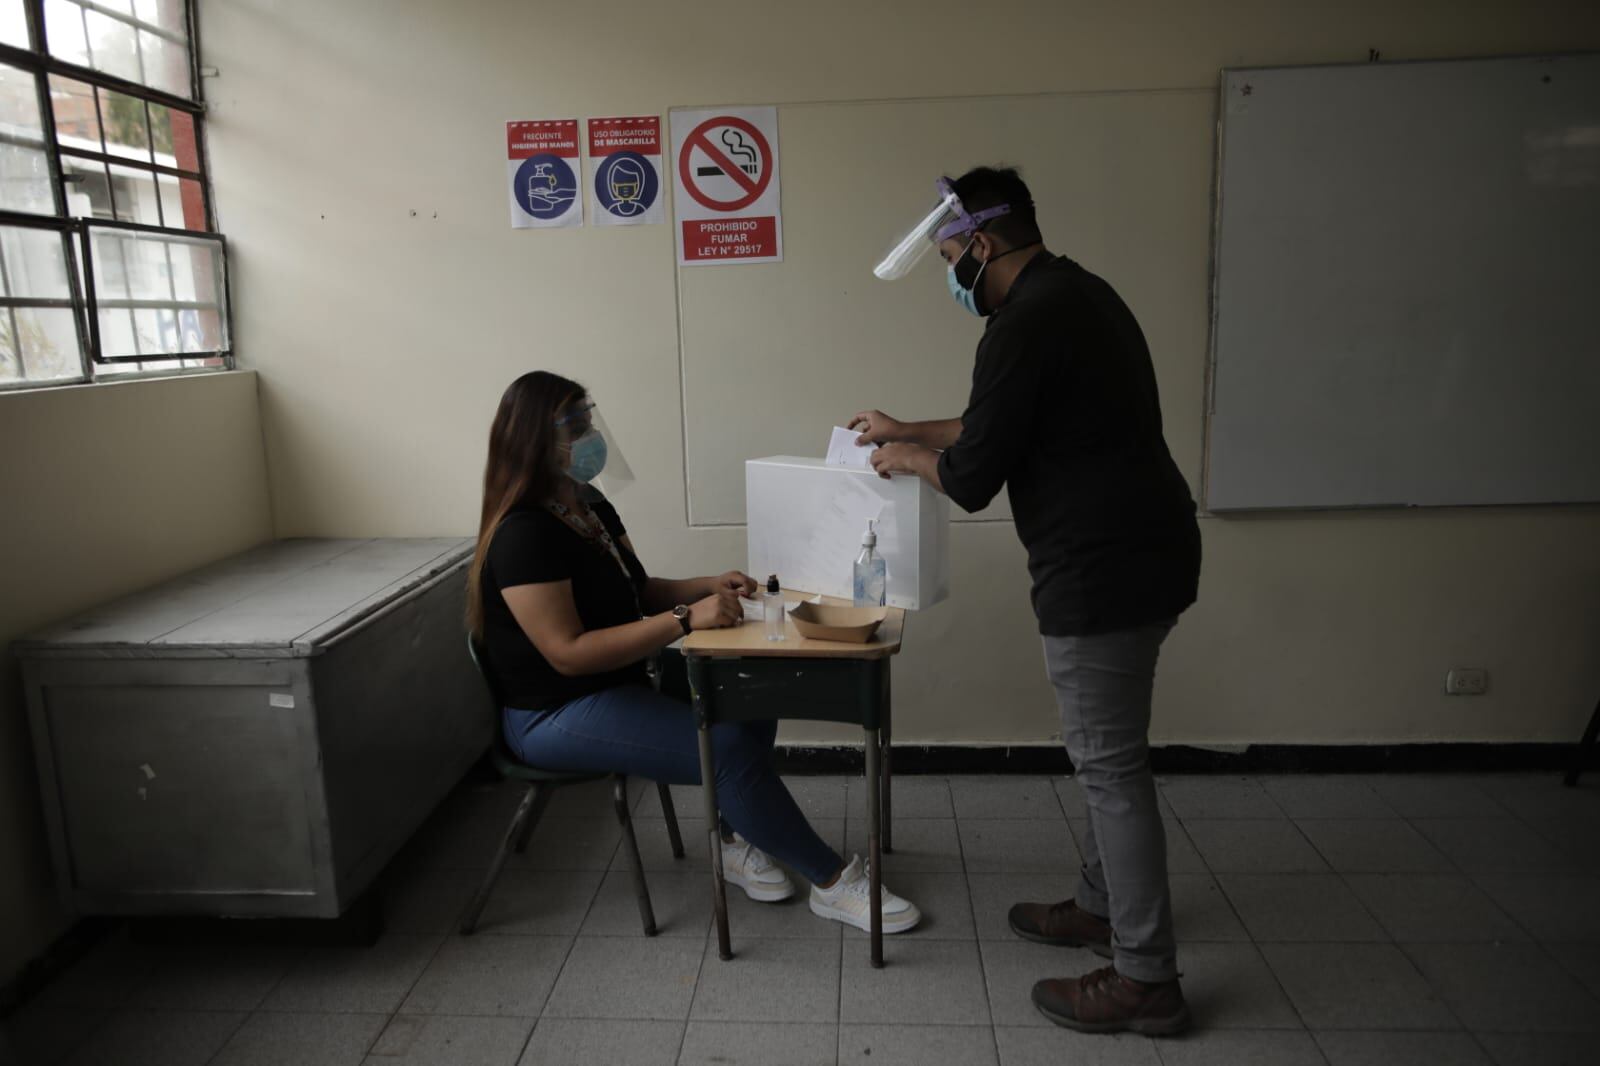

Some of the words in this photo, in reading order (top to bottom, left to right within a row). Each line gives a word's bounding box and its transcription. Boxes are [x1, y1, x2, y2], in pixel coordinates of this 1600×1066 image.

[523, 132, 562, 140] FRECUENTE
[594, 130, 608, 138] USO
[610, 129, 656, 137] OBLIGATORIO
[549, 141, 574, 149] MANOS
[594, 139, 606, 147] DE
[607, 138, 656, 146] MASCARILLA
[700, 221, 757, 232] PROHIBIDO
[711, 233, 748, 244] FUMAR
[698, 246, 717, 256] LEY
[734, 244, 761, 255] 29517
